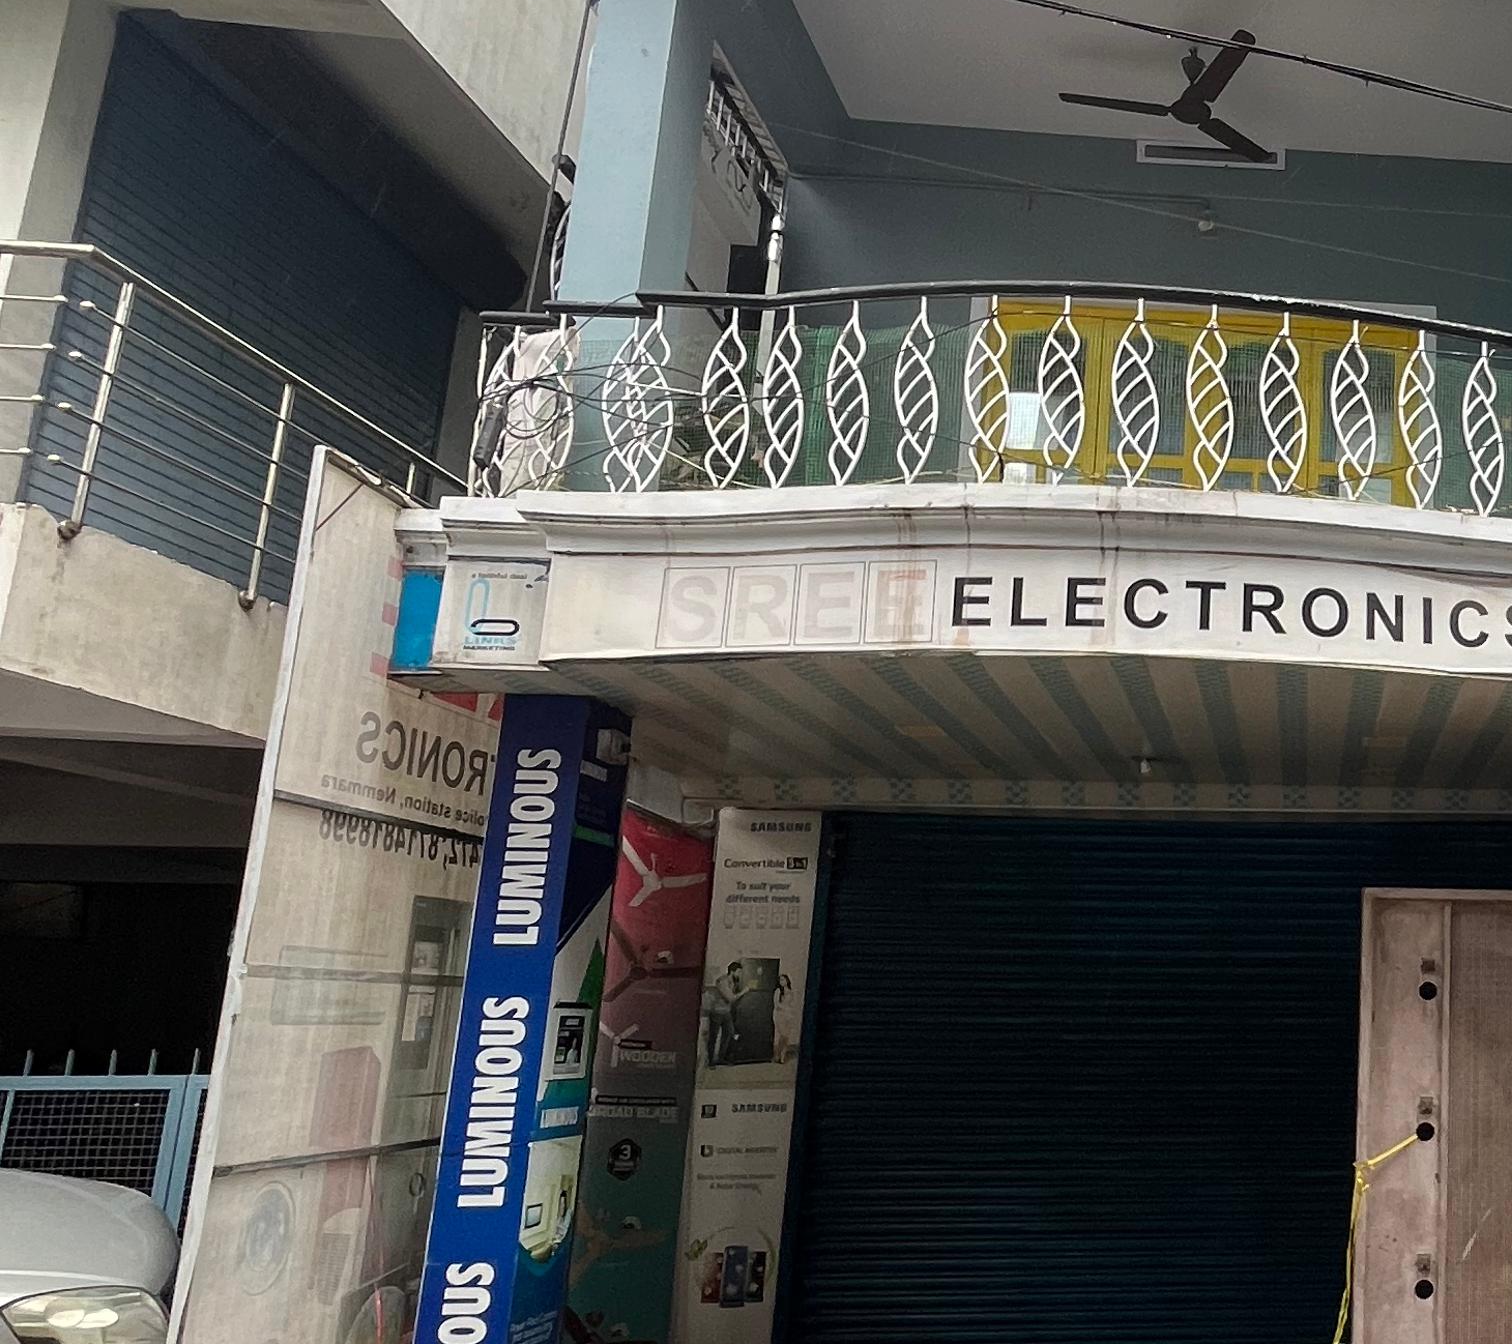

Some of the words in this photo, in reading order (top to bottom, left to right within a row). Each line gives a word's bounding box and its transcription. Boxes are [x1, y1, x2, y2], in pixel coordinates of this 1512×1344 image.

[668, 569, 927, 642] SREE
[493, 749, 562, 945] LUMINOUS
[750, 822, 812, 832] SAMSUNG
[723, 858, 785, 869] Convertible
[457, 996, 530, 1208] LUMINOUS
[731, 1103, 787, 1113] SAMSUNG
